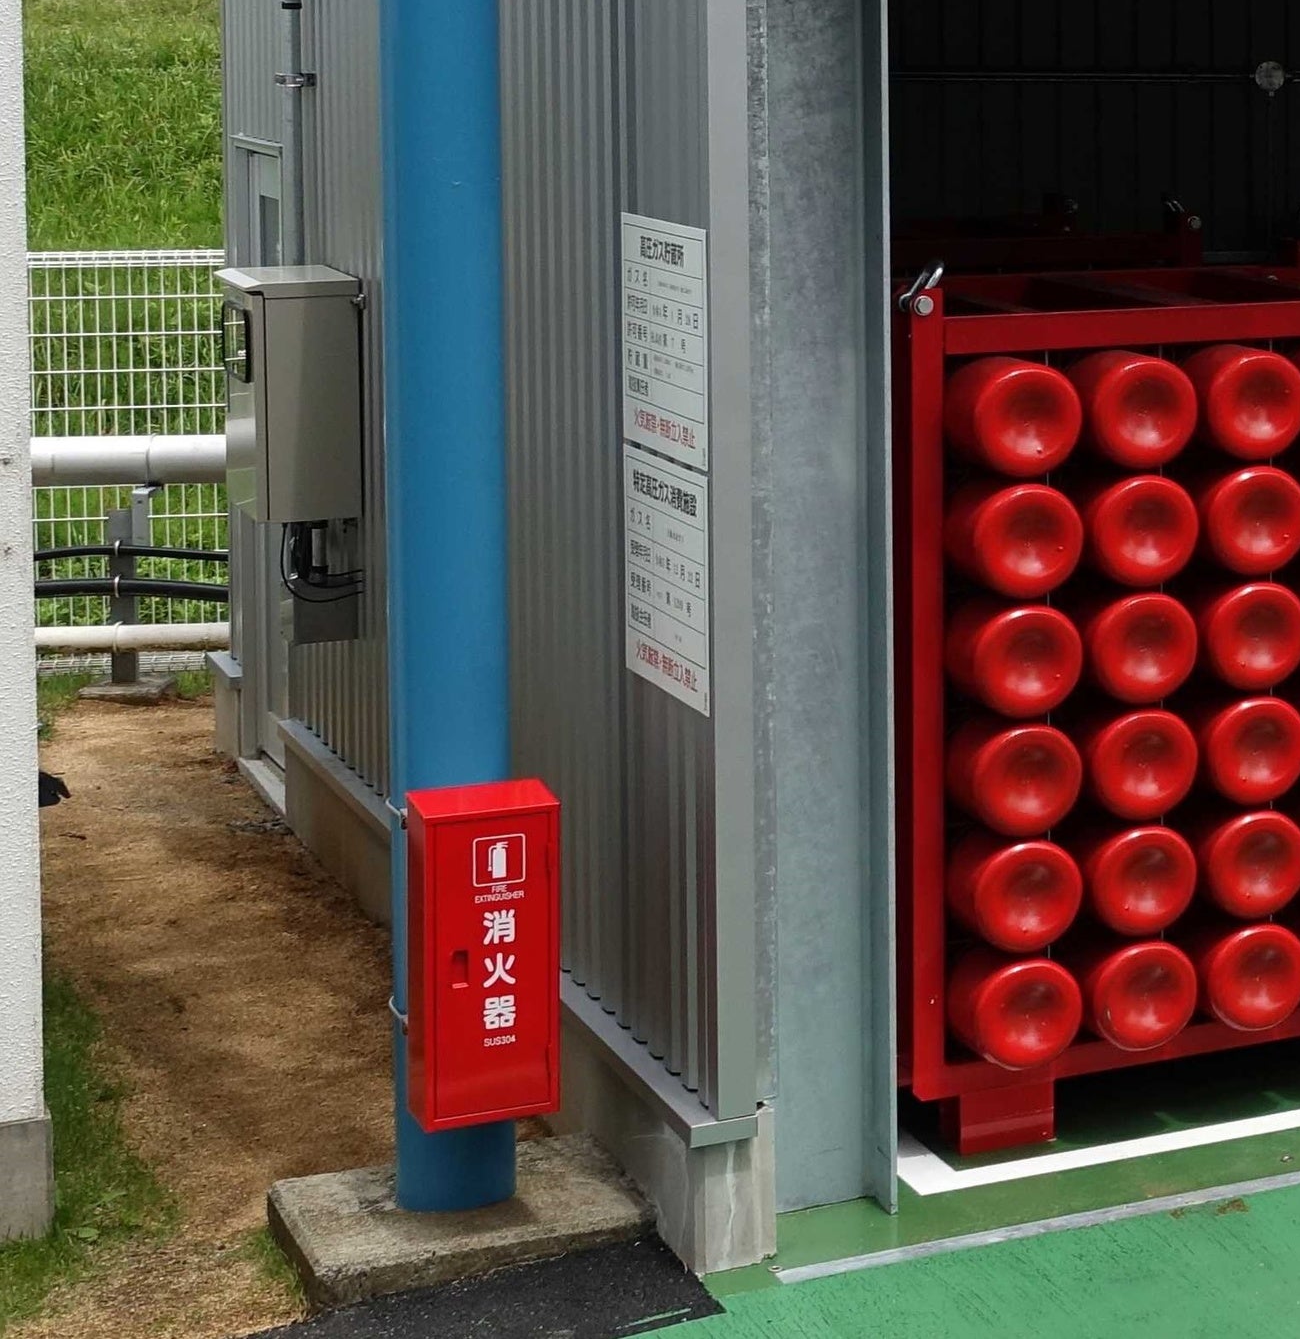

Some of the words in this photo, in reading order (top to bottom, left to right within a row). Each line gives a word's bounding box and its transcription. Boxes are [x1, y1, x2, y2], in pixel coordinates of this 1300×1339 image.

[492, 884, 507, 893] FIRE
[475, 890, 524, 903] EXTINGUISHER
[483, 909, 516, 1030] 消火器
[484, 1034, 516, 1047] SUS304
